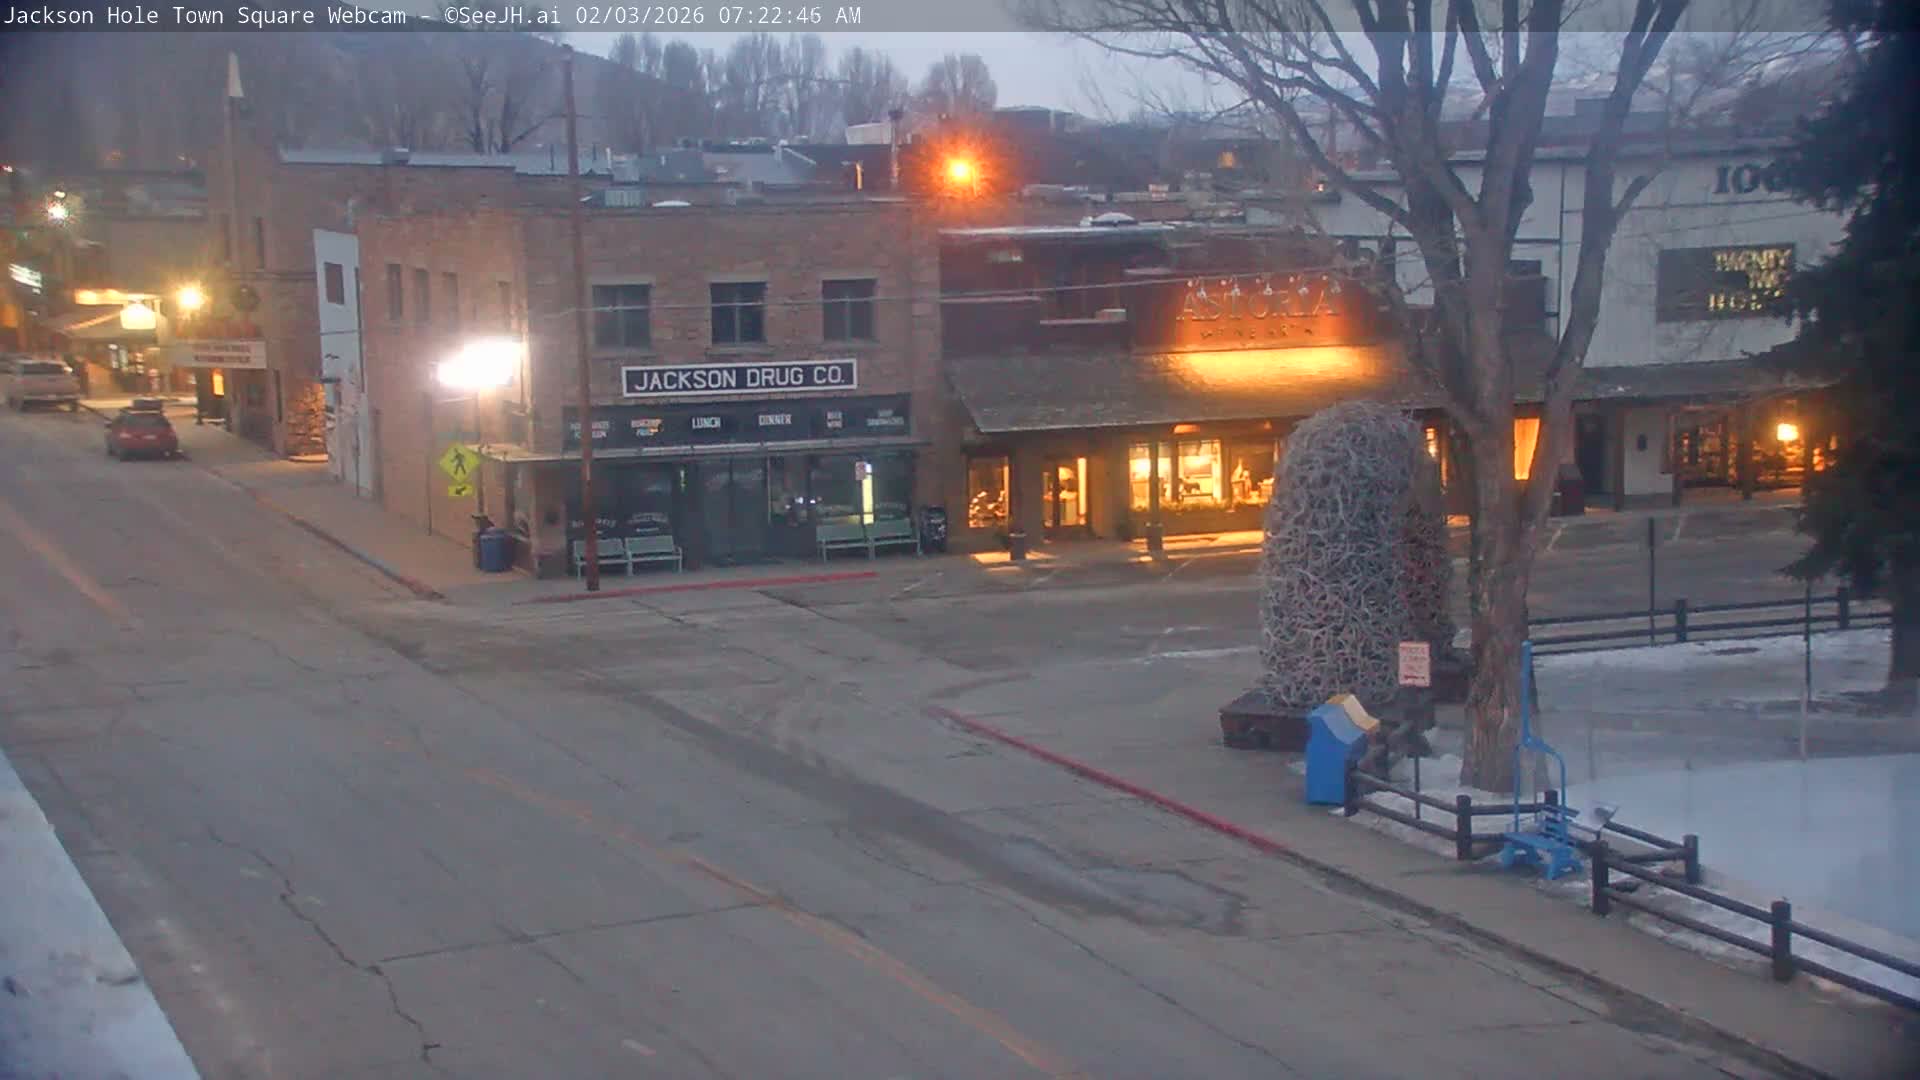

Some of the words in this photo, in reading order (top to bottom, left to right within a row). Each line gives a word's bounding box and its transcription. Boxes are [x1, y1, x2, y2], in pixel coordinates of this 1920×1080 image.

[1175, 287, 1342, 321] ASTORIA
[634, 370, 737, 391] JACKSON
[746, 367, 804, 388] DRUG
[813, 365, 846, 385] CO.
[691, 416, 721, 429] LUNCH
[758, 413, 792, 426] DINNER
